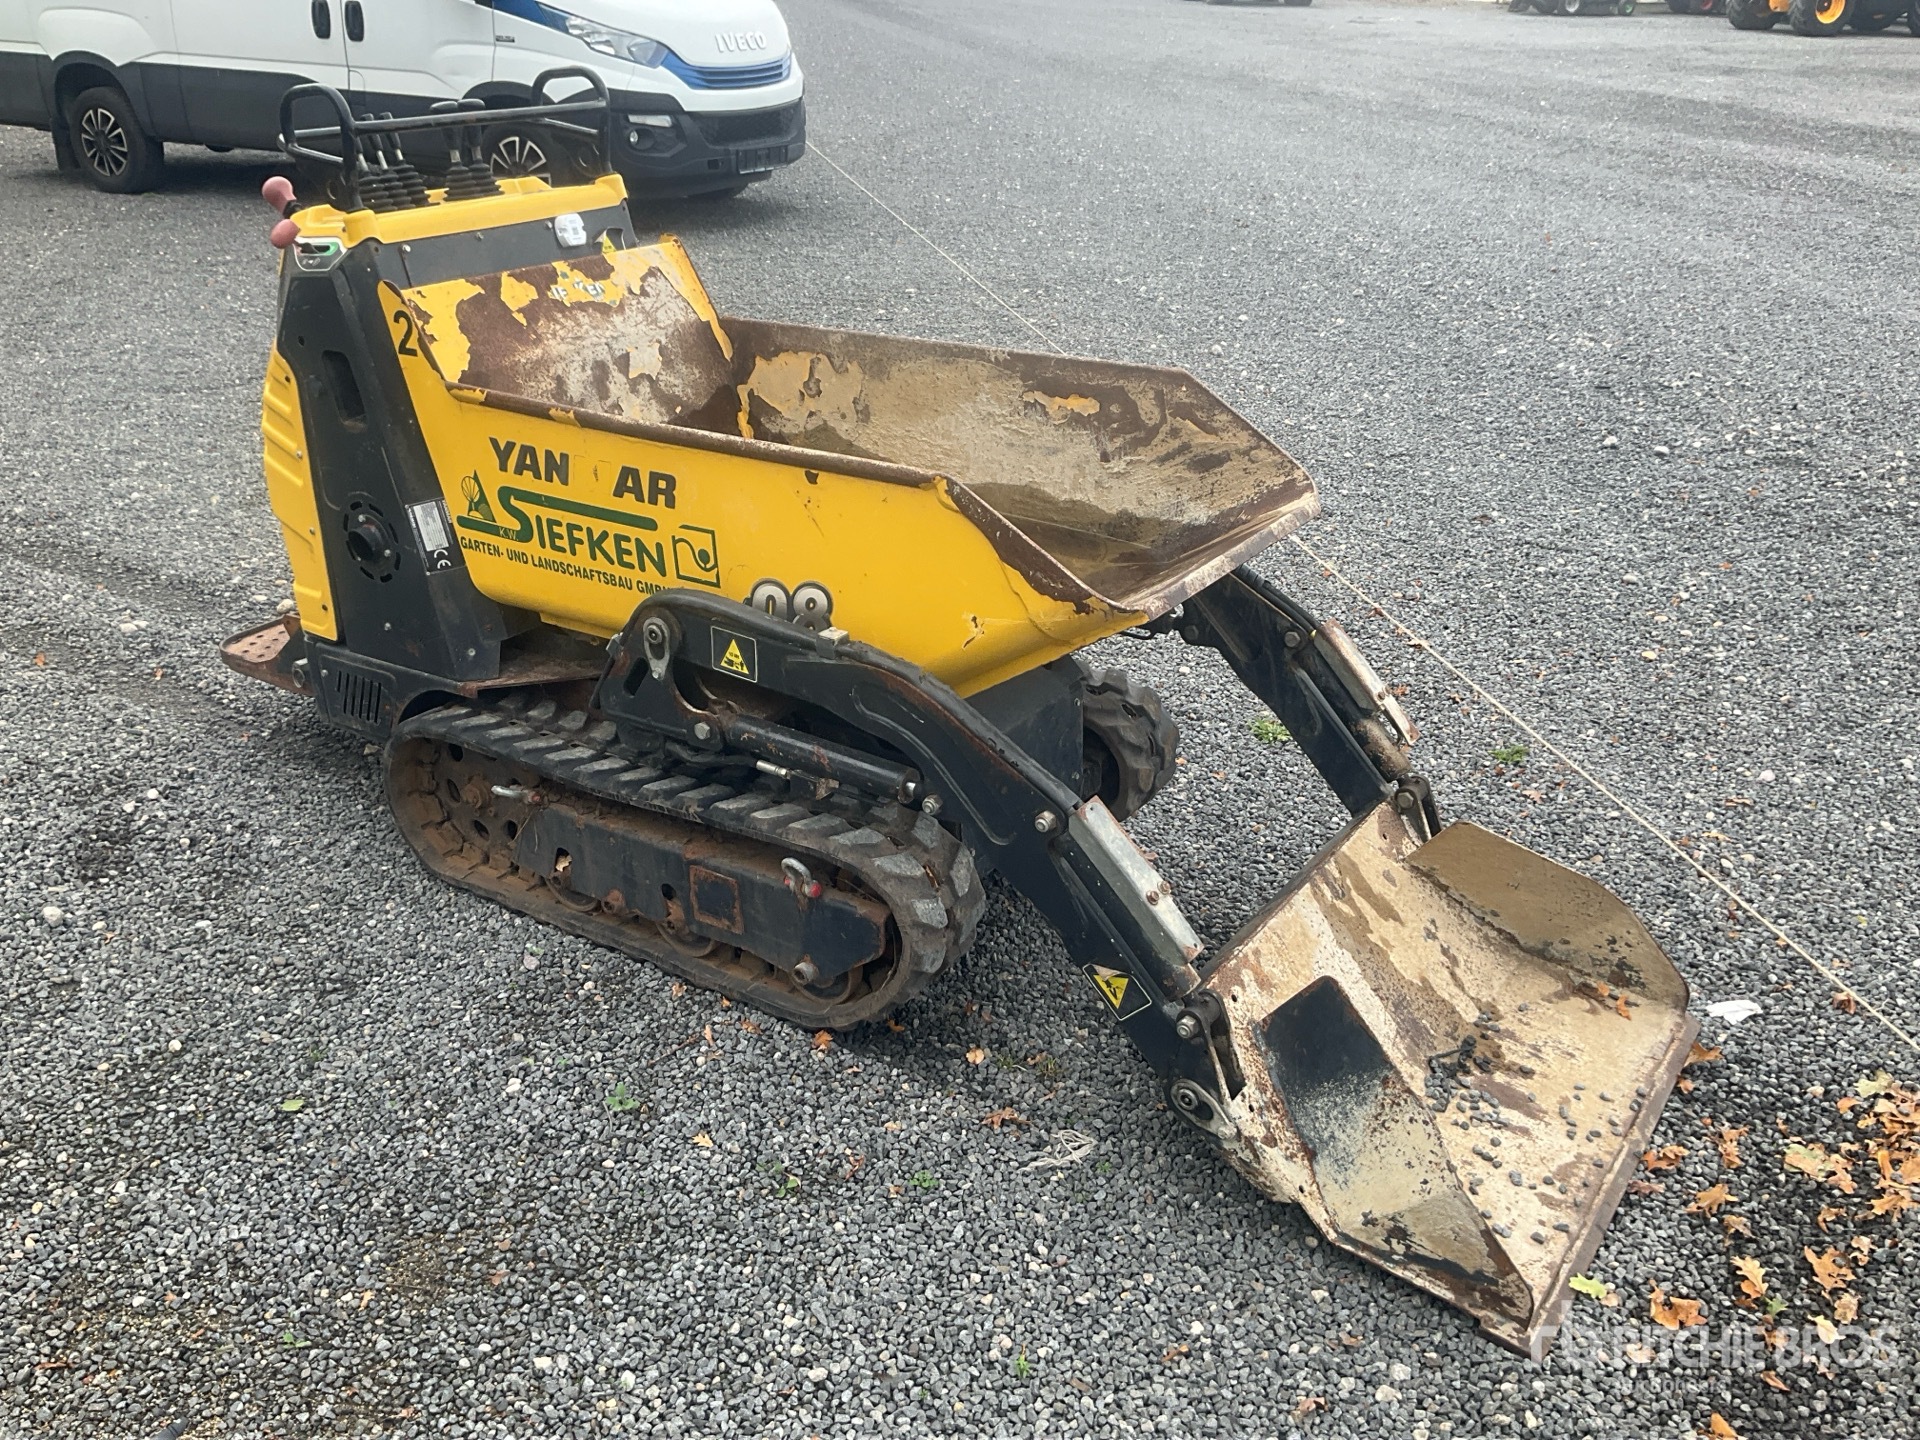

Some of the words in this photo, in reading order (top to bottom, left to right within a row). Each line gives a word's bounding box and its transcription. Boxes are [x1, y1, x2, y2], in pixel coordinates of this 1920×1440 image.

[715, 31, 767, 53] IVECO
[393, 310, 418, 357] 2
[457, 485, 667, 578] SIEFKEN
[460, 536, 504, 558] GARTEN-
[506, 547, 529, 565] UND
[531, 553, 633, 591] LANDSCHAFTSBAU
